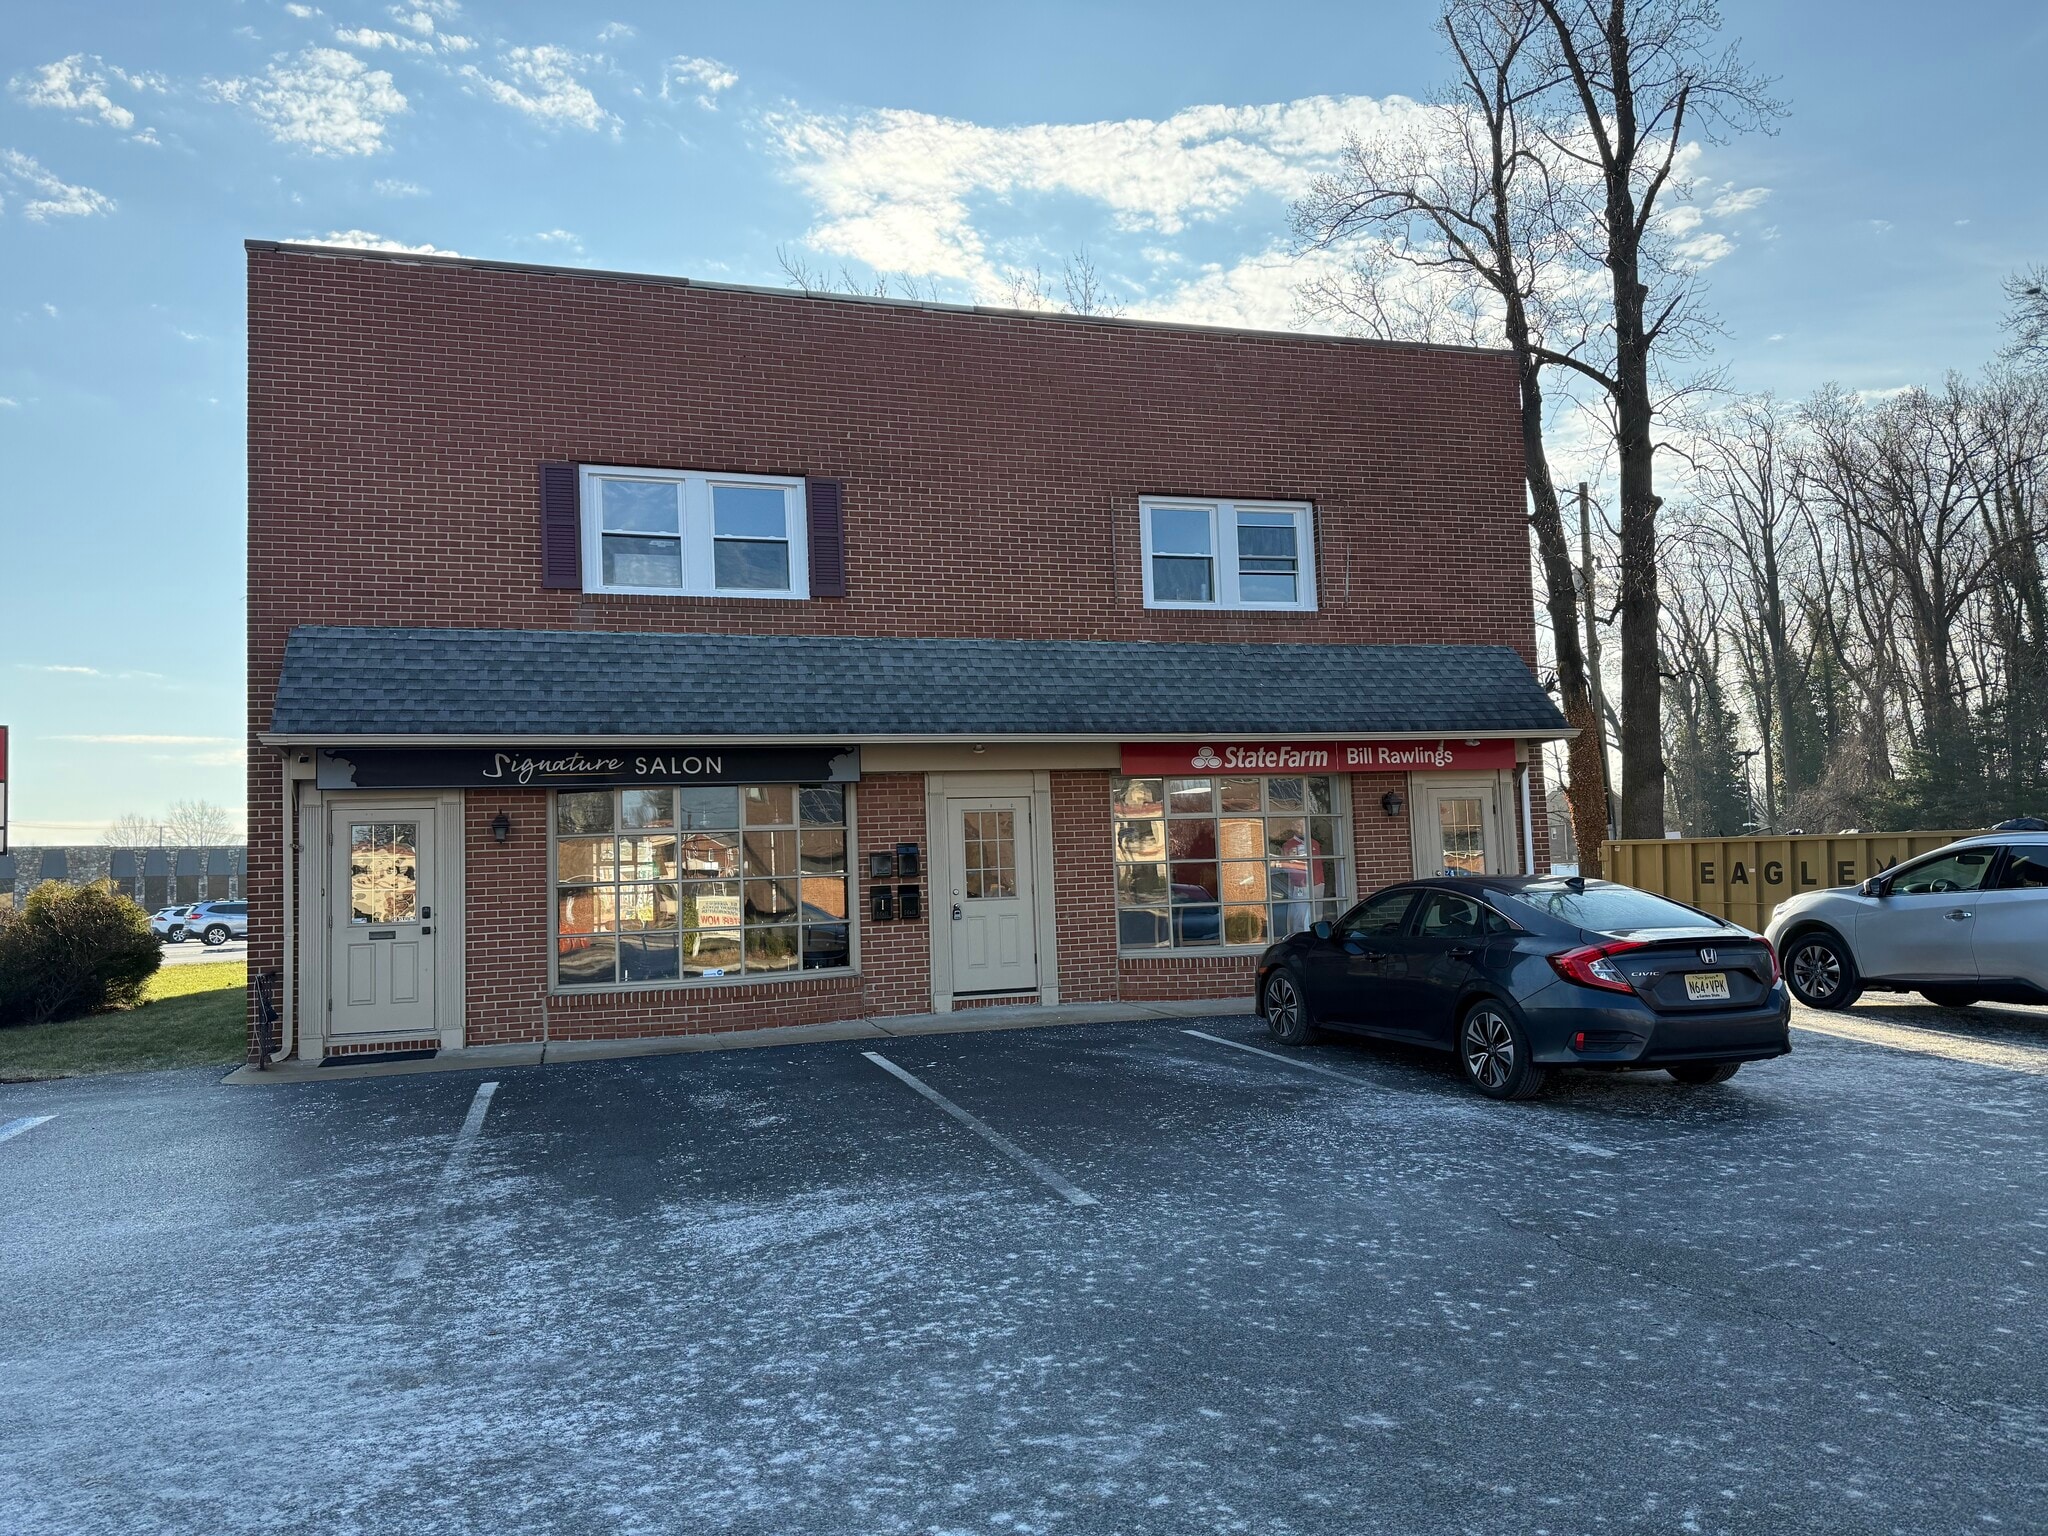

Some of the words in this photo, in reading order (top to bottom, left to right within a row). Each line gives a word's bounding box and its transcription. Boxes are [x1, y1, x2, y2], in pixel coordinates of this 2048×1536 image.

[482, 752, 625, 785] Signature
[635, 756, 722, 775] SALON
[1346, 747, 1373, 765] Bill
[1378, 747, 1453, 767] Rawlings
[1700, 861, 1856, 886] EAGLE
